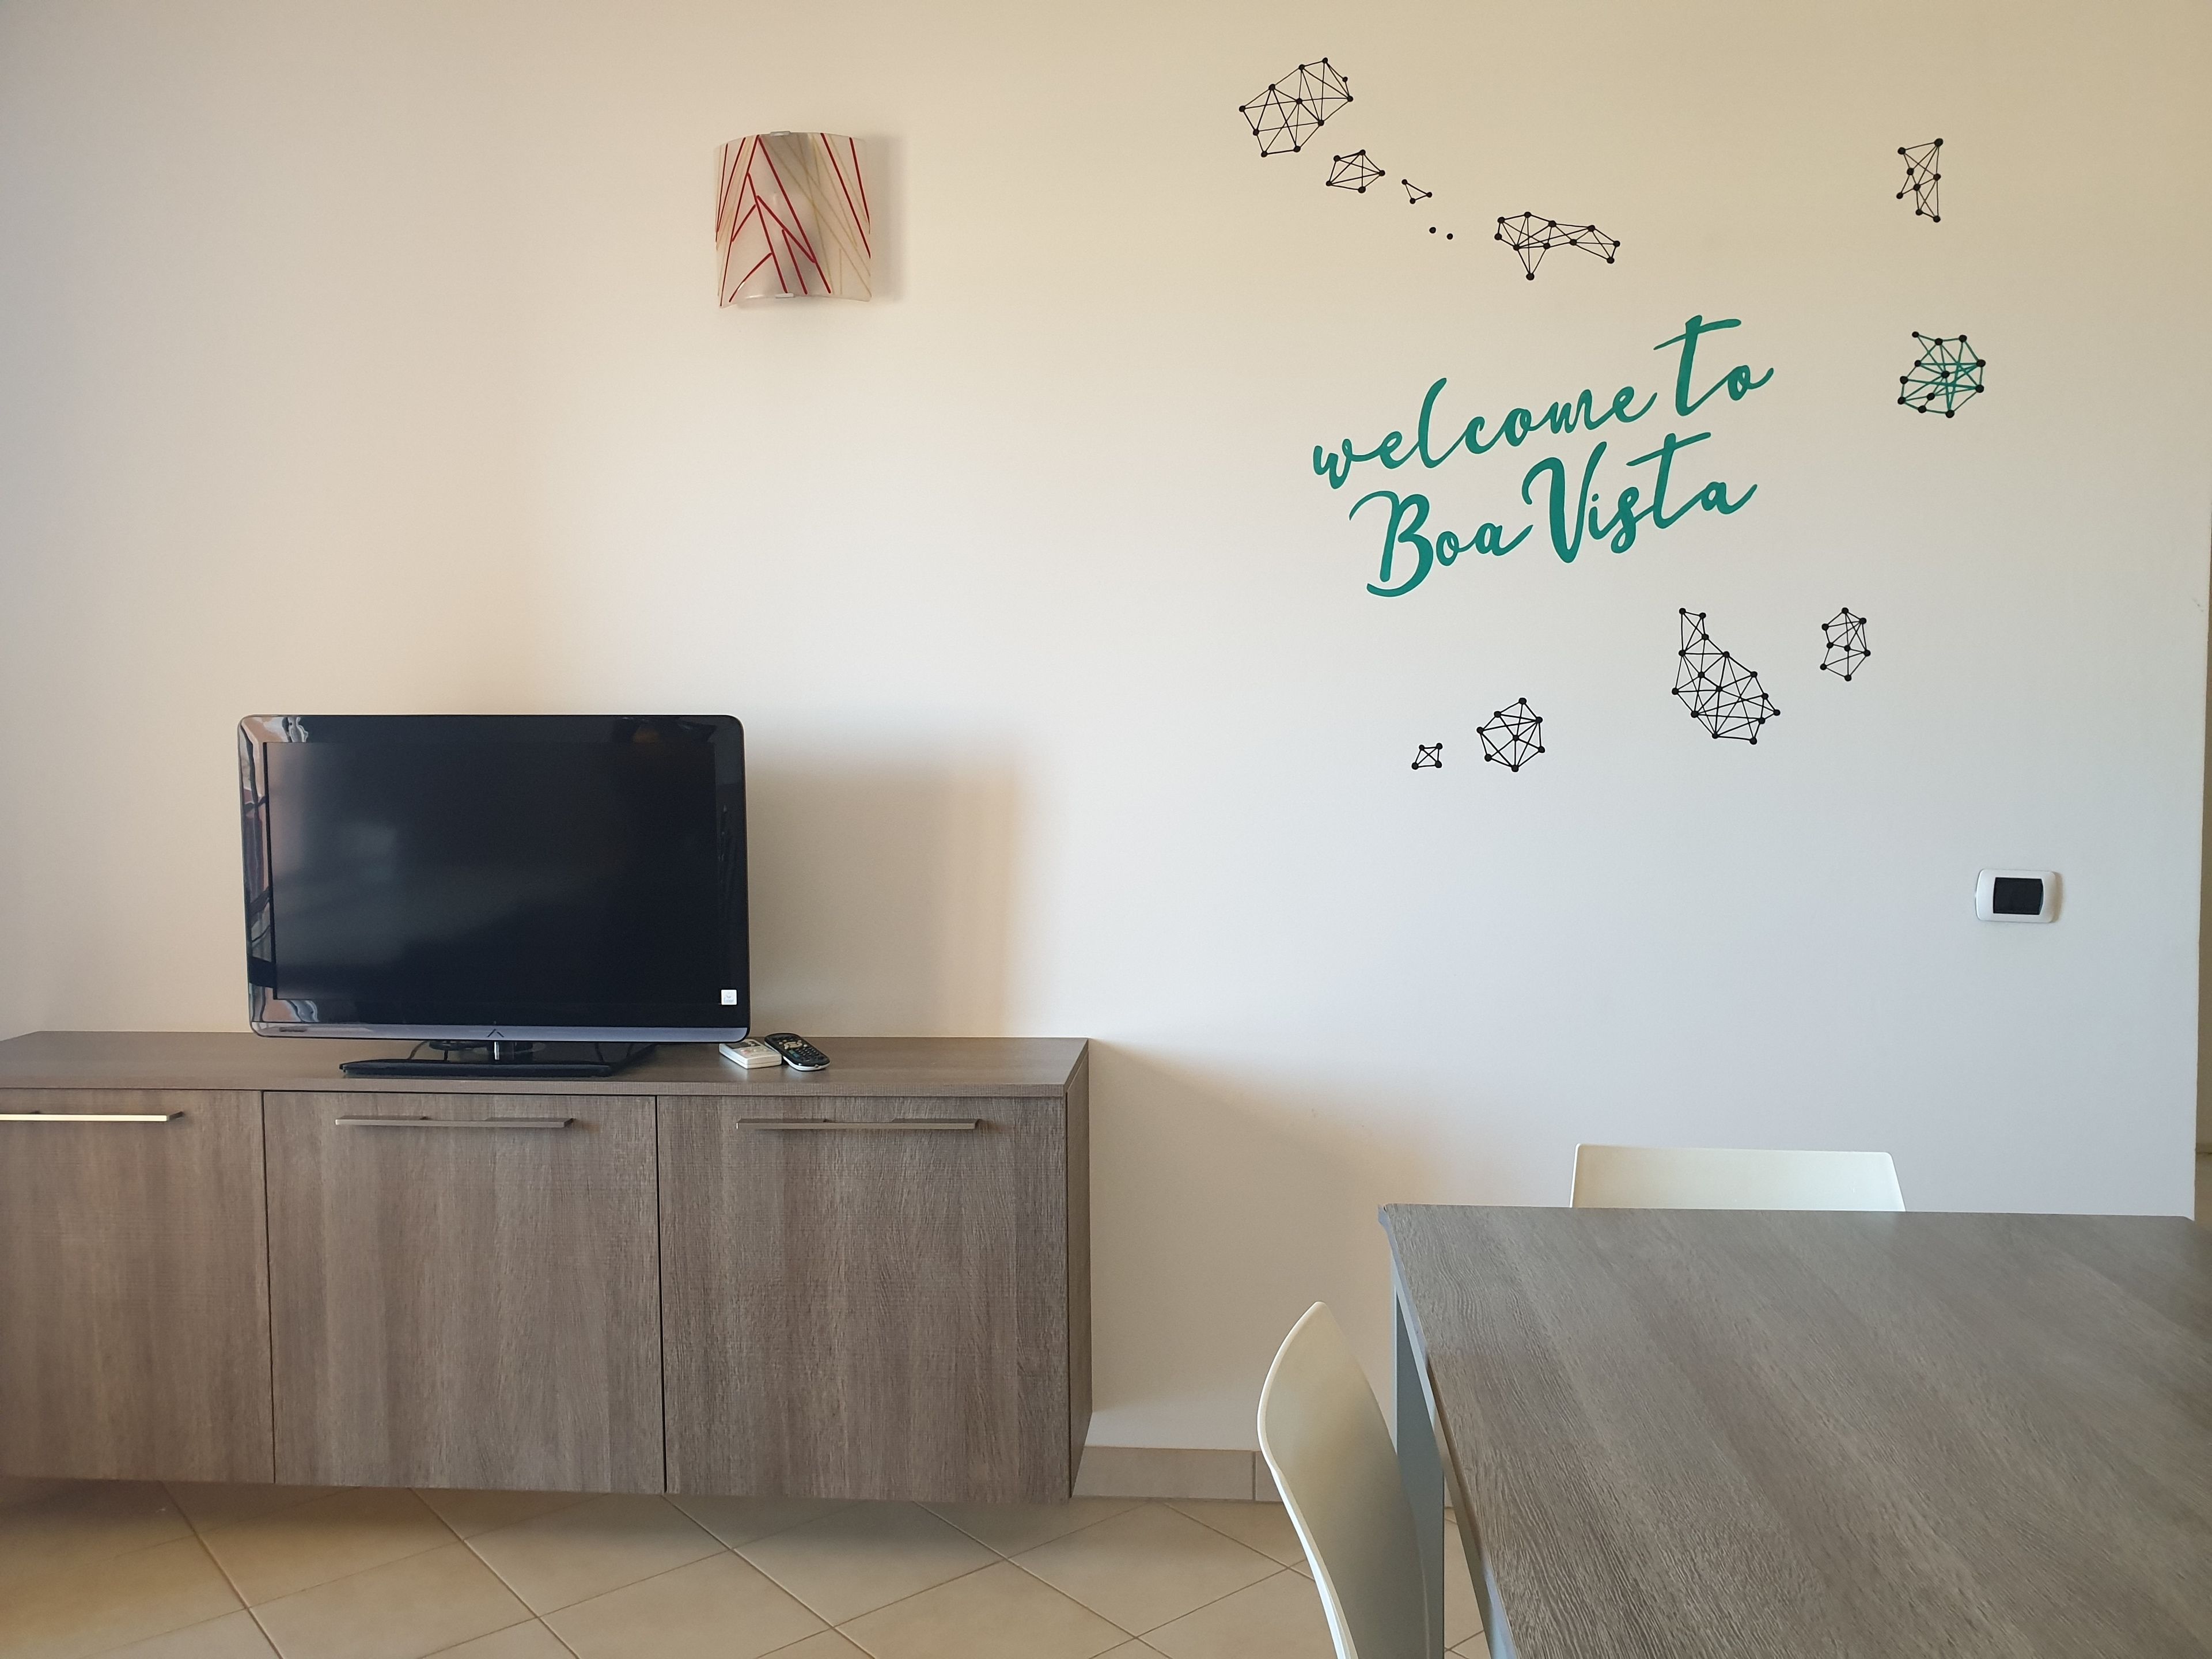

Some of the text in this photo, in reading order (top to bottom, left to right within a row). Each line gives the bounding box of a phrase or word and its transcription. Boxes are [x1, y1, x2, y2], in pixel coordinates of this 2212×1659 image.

[1313, 377, 1658, 489] welcome
[1349, 432, 1758, 598] Boa Vista
